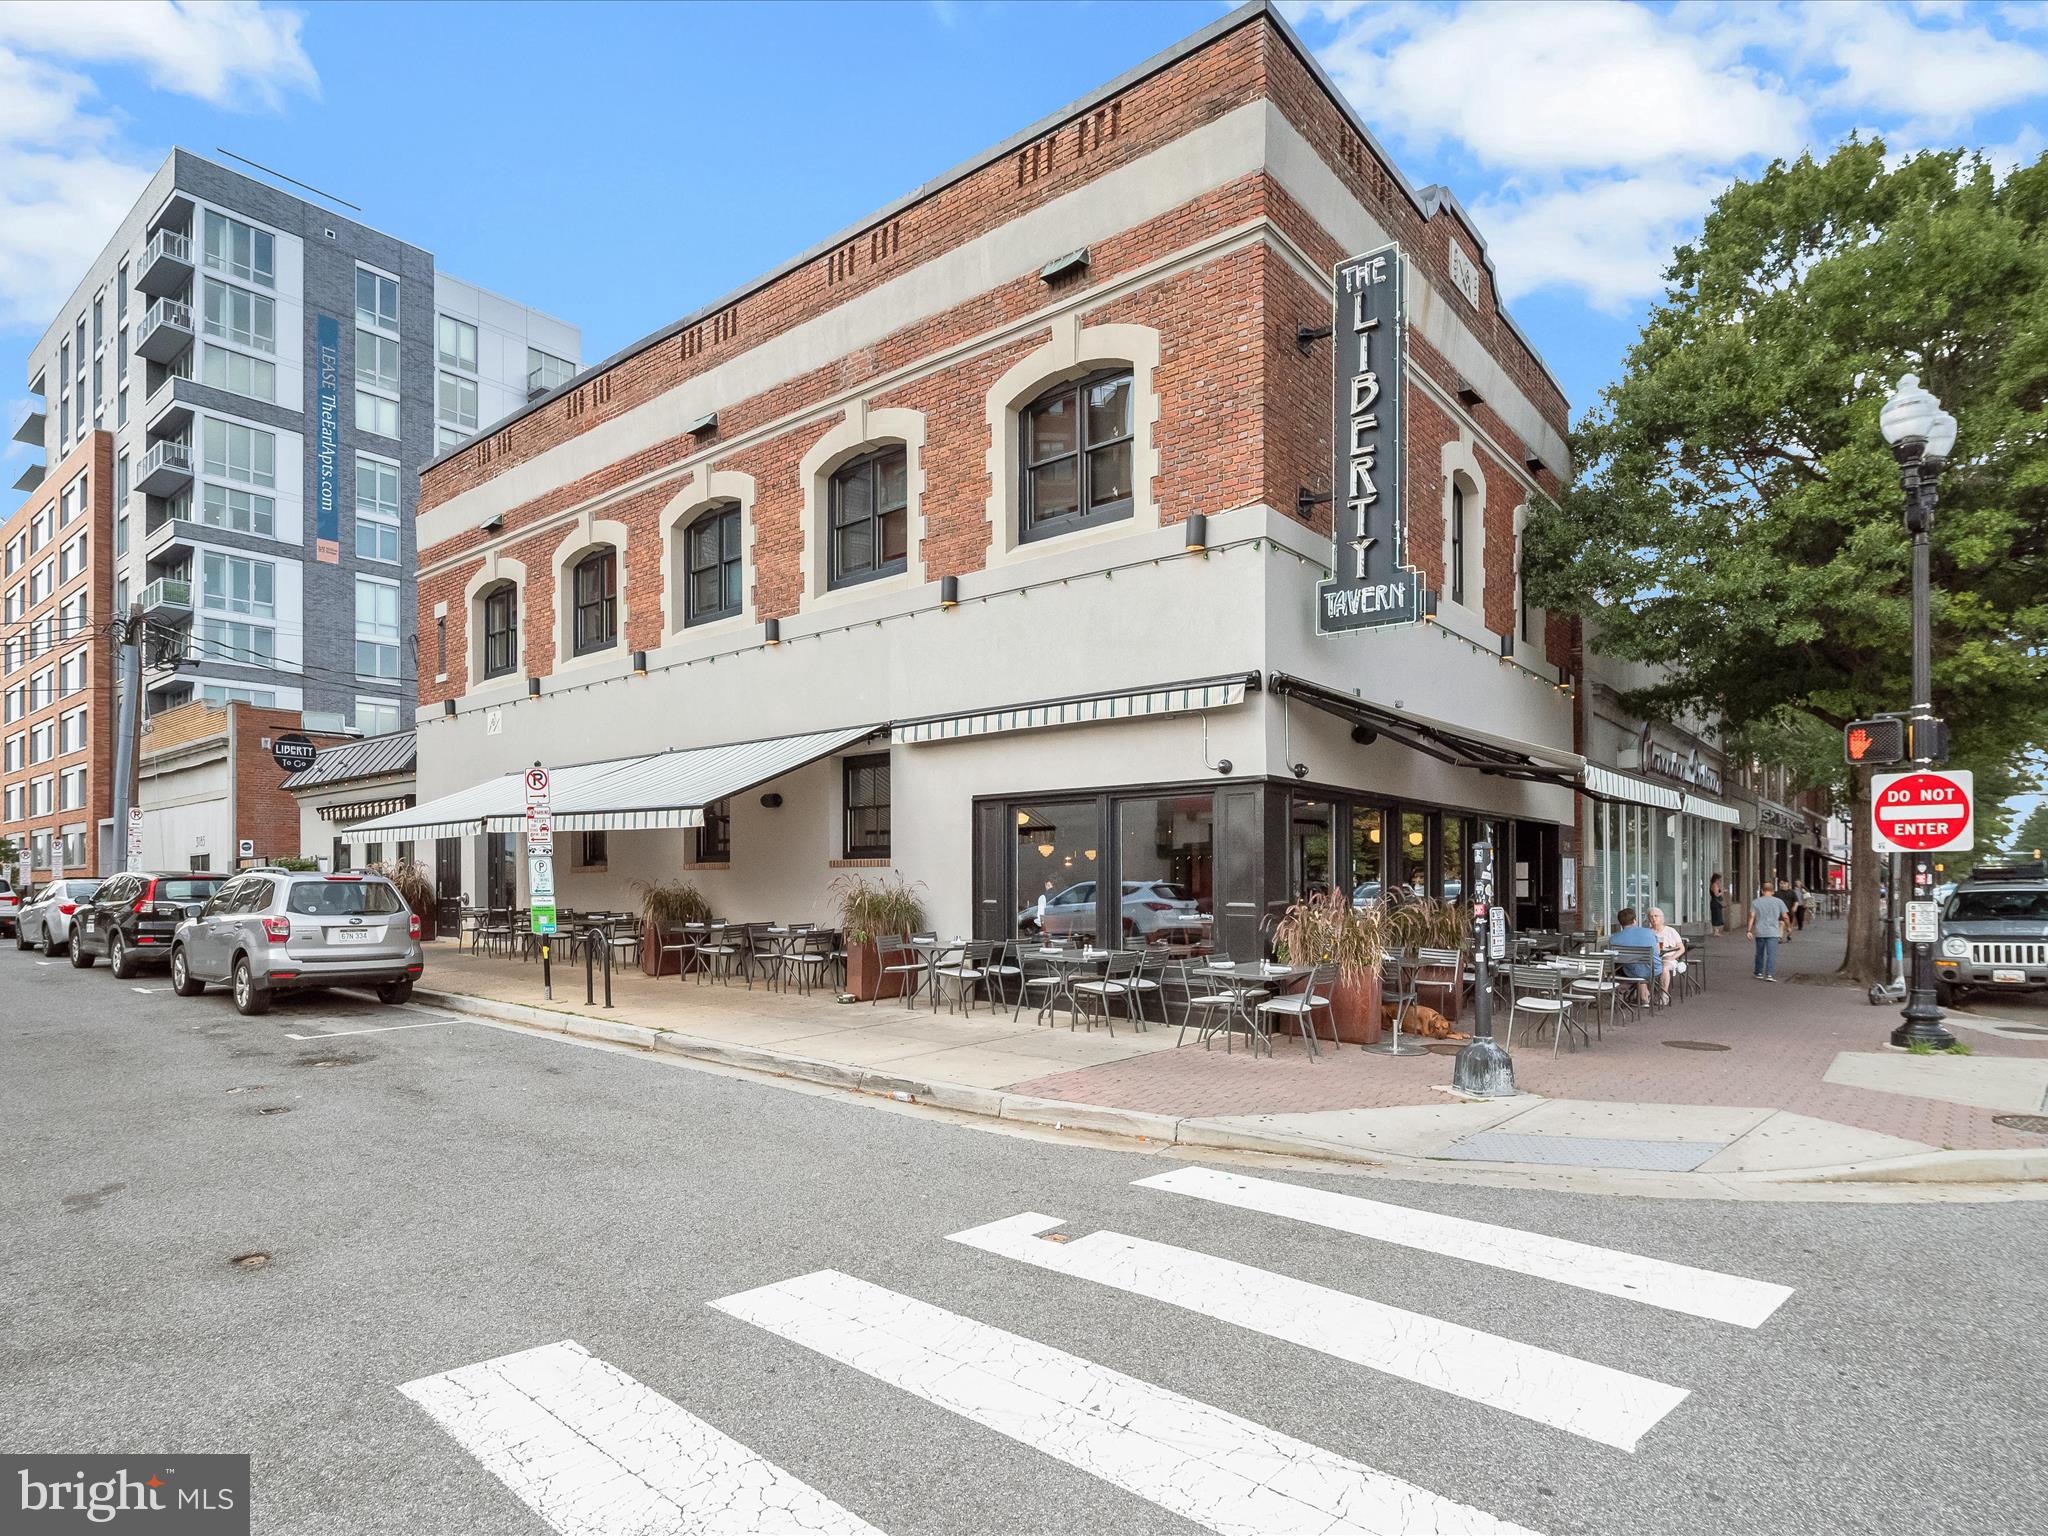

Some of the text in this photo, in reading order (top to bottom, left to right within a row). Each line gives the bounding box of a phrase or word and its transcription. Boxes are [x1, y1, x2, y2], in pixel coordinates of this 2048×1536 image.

[1341, 256, 1386, 293] THE
[318, 346, 336, 511] LEASE TheEarlApts.com
[1347, 291, 1380, 579] LIBERTY
[1324, 581, 1406, 618] TAVERN
[275, 744, 313, 757] LIBERTY
[282, 759, 307, 768] To Go
[1887, 787, 1955, 803] DO NOT
[1894, 822, 1949, 836] ENTER
